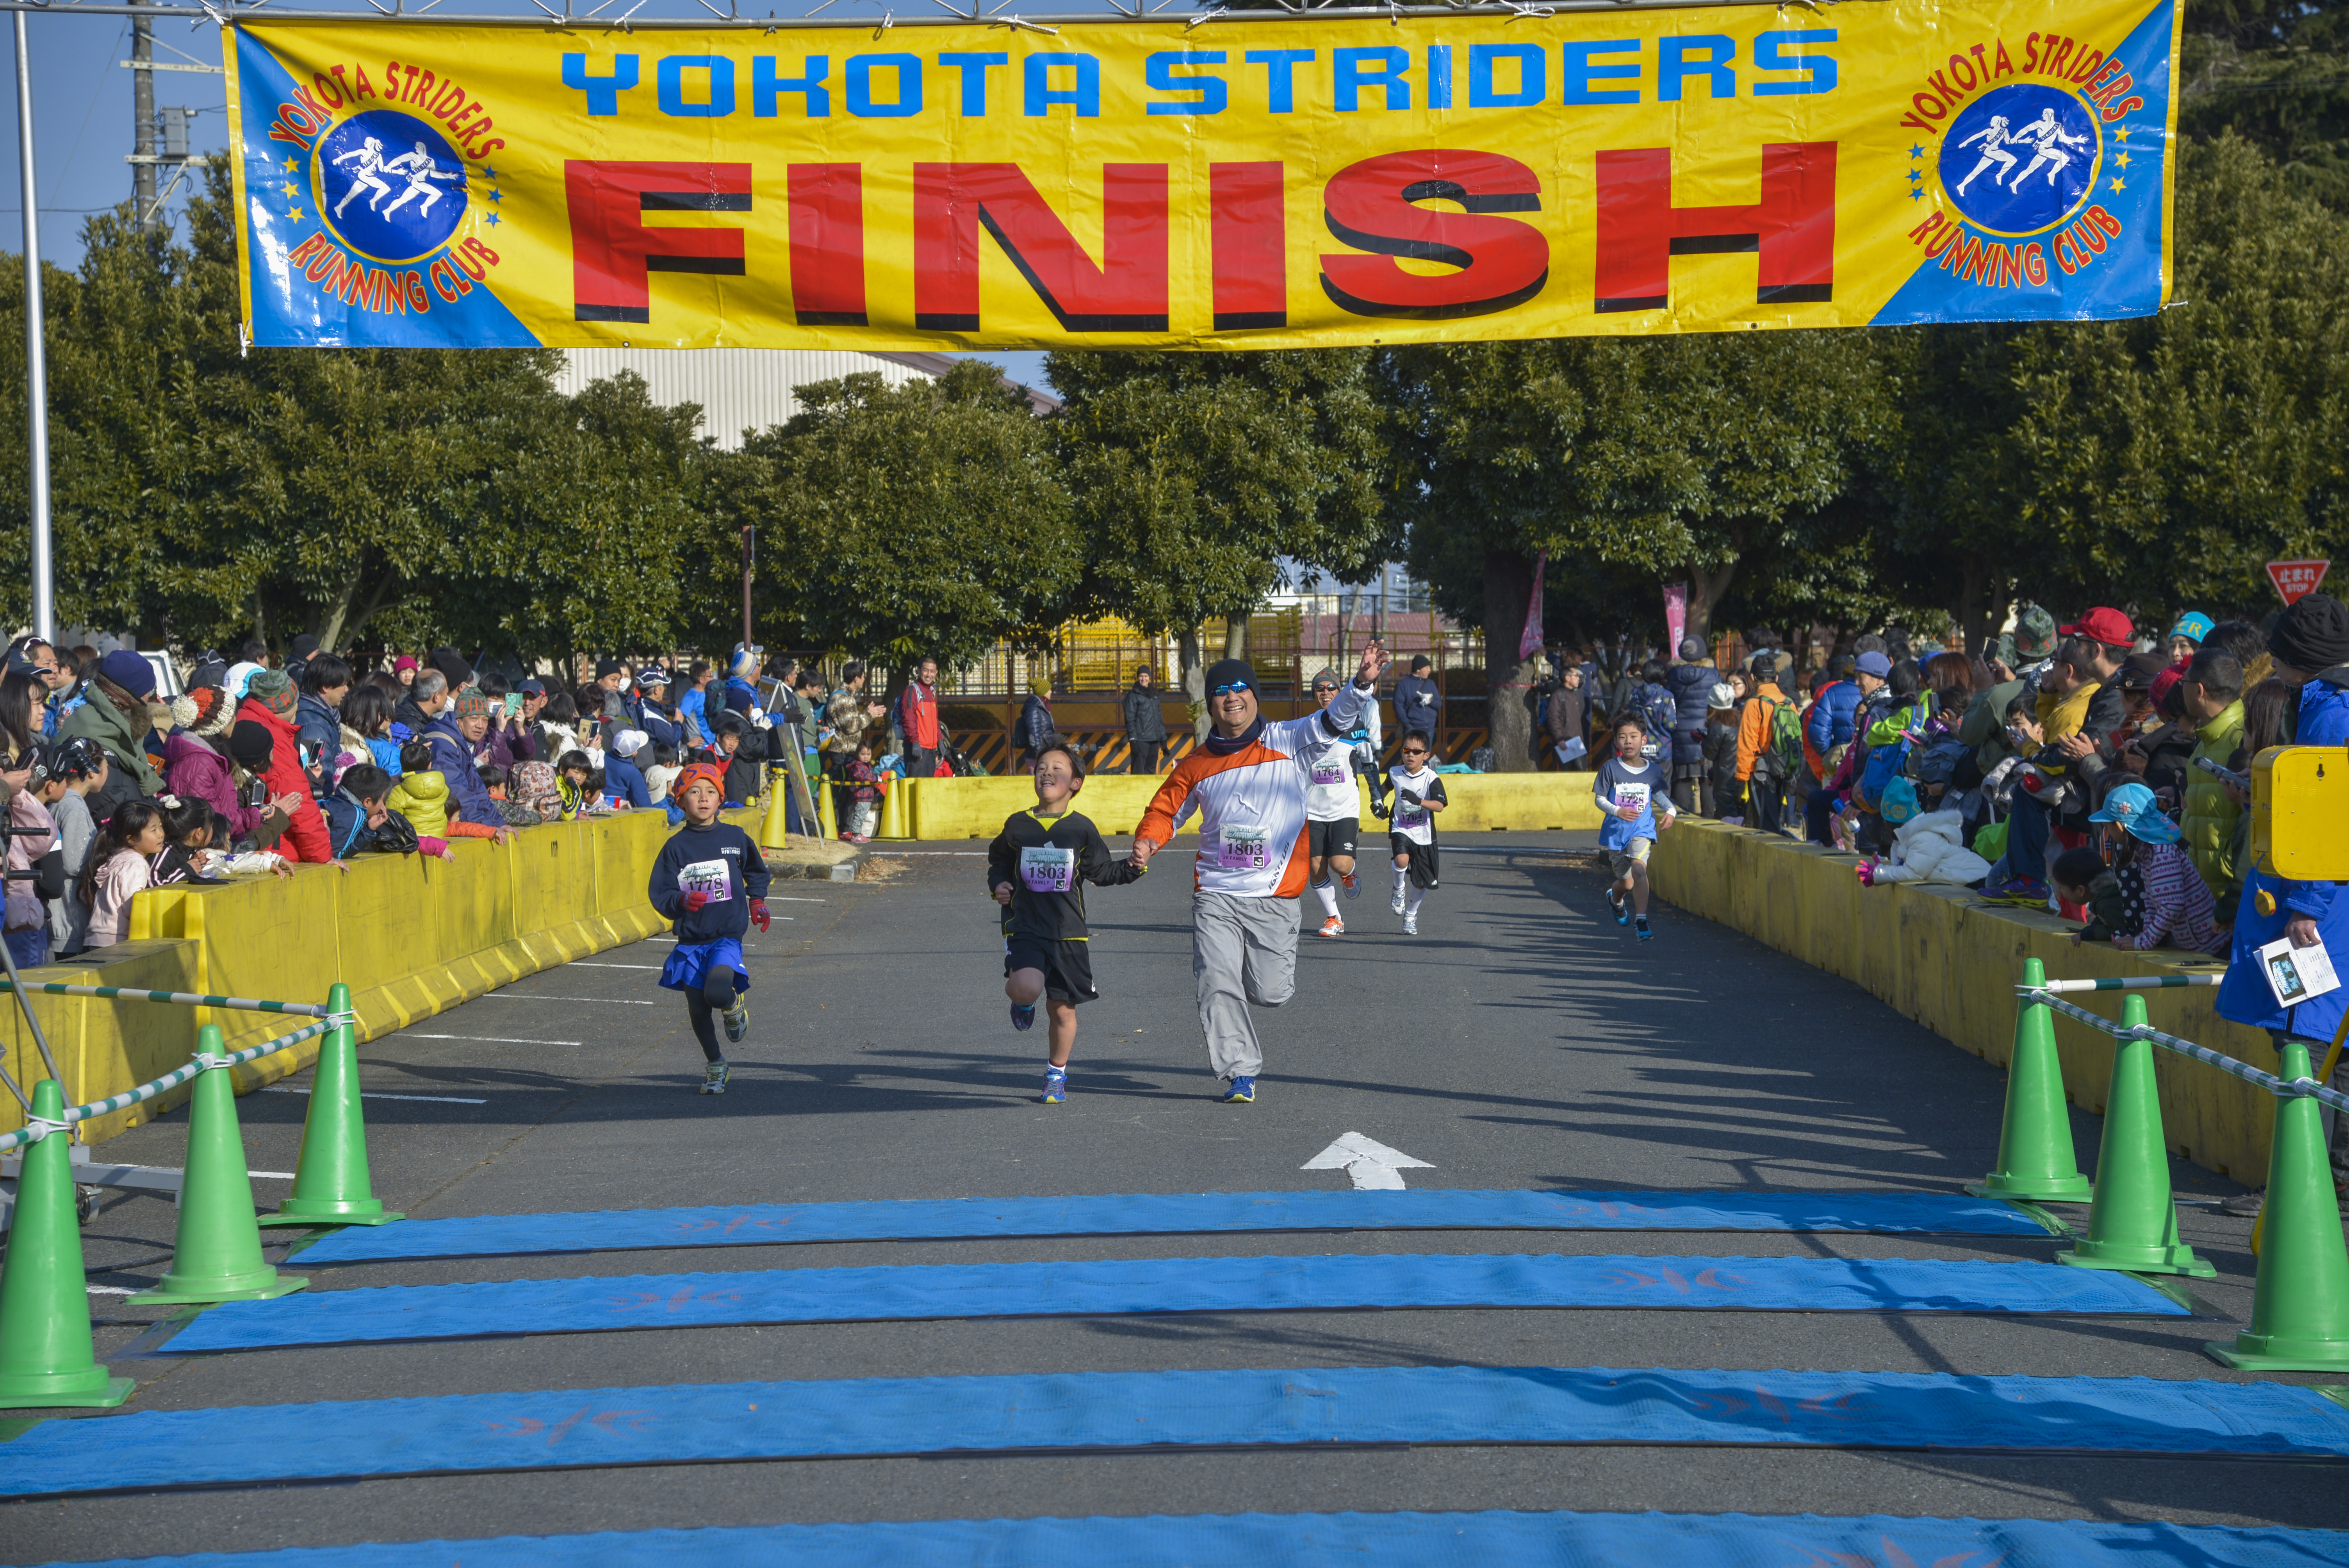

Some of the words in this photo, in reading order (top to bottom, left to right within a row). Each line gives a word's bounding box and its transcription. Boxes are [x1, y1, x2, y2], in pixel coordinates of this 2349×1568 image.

[561, 52, 1100, 118] YOKOTA
[1146, 28, 1838, 116] STRIDERS
[1900, 37, 2014, 135] YOKOTA
[2023, 32, 2144, 122] STRIDERS
[268, 62, 376, 151] YOKOTA
[384, 61, 505, 159] STRIDERS
[1989, 128, 2005, 145] STRIDERS
[2041, 124, 2059, 140] STRIDERS
[565, 141, 1837, 333] FINISH
[1908, 210, 2047, 288] RUNNING
[2053, 205, 2121, 275] CLUB
[287, 232, 430, 315] RUNNING
[430, 237, 500, 303] CLUB
[2279, 567, 2315, 583] 止まれ
[2286, 583, 2309, 593] STOP
[1621, 795, 1644, 804] 1728
[1402, 813, 1422, 821] 1764
[1227, 843, 1263, 855] 1803
[1028, 867, 1065, 879] 1803
[688, 878, 724, 891] 1778
